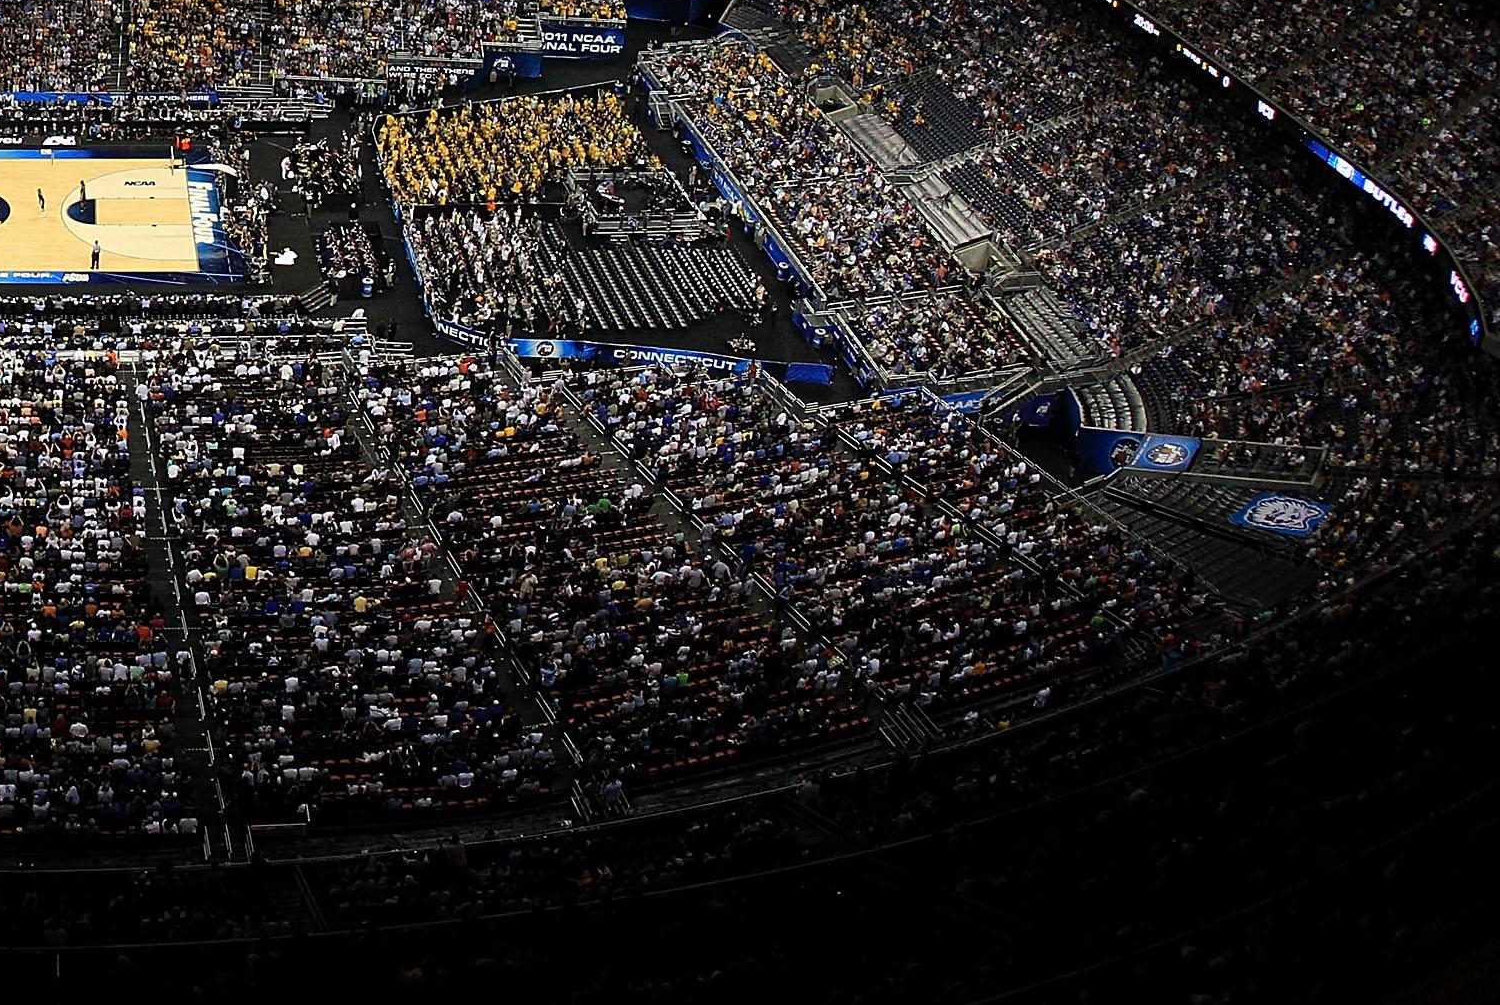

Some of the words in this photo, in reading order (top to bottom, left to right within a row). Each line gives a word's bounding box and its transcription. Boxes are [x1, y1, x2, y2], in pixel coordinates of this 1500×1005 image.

[541, 32, 567, 42] 011
[572, 33, 614, 44] NCAA
[581, 43, 621, 54] FOUR
[389, 65, 414, 73] AND
[418, 66, 441, 74] THEN
[1363, 178, 1414, 228] BUTLER
